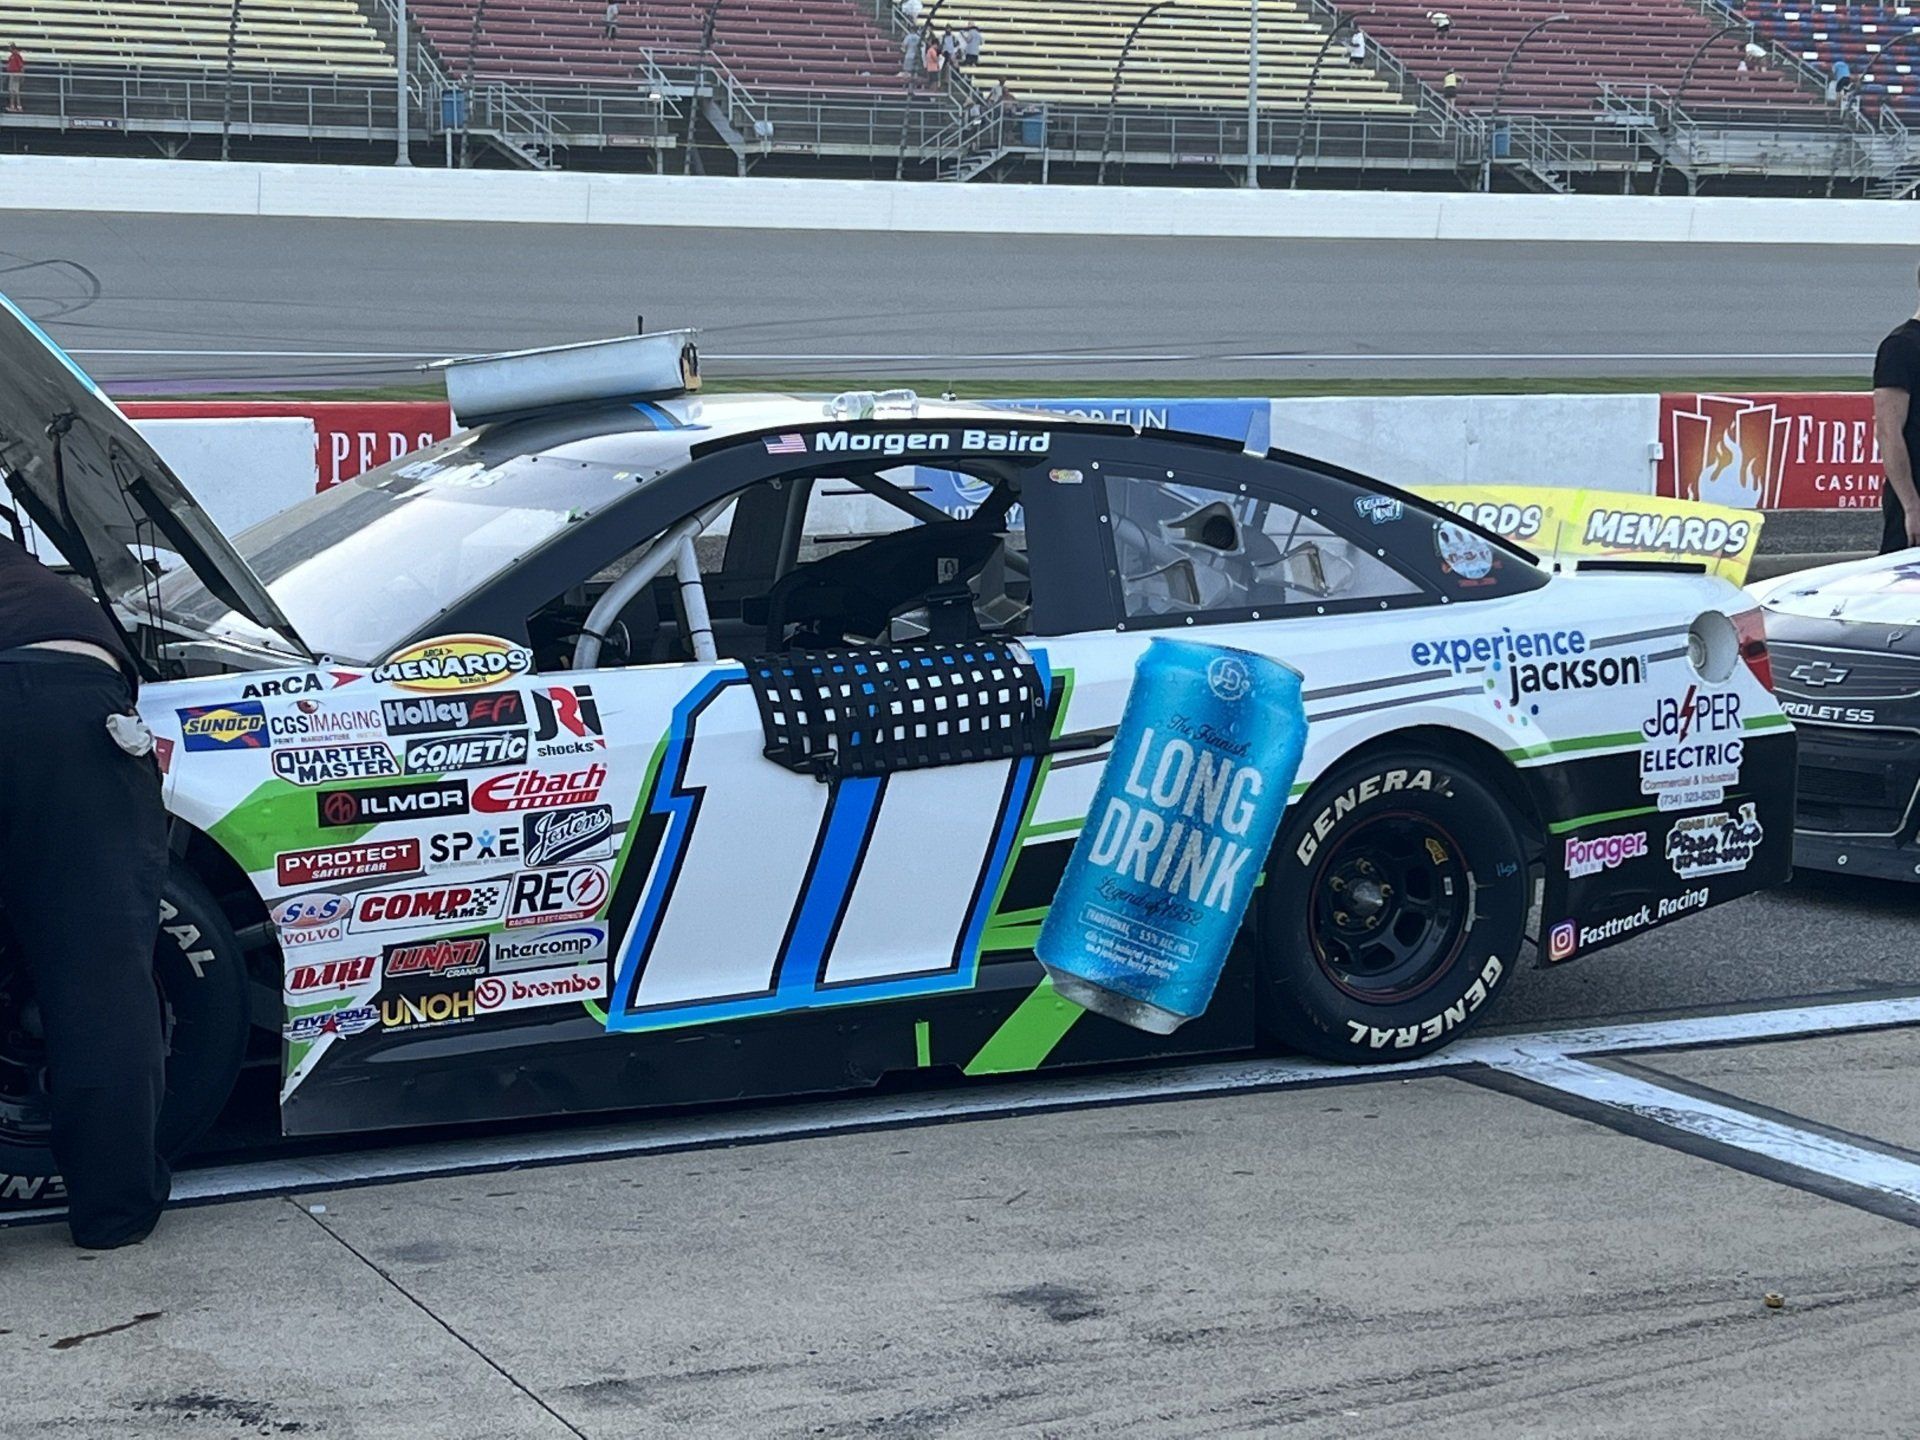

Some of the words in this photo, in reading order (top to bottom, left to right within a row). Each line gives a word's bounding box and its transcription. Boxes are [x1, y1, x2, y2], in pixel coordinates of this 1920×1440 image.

[815, 430, 949, 456] Morgen
[962, 429, 1051, 453] Baird
[1815, 473, 1887, 491] CASIN
[1586, 510, 1750, 552] MENARDS
[1411, 627, 1585, 674] experience
[374, 650, 530, 683] MENARDS
[1508, 653, 1641, 707] jackson
[242, 673, 324, 699] ARCA
[187, 715, 263, 735] SUNOCO
[385, 700, 468, 728] Holley
[469, 694, 517, 722] EFI
[1779, 702, 1846, 721] VROLET
[1846, 708, 1876, 723] SS
[273, 737, 294, 745] PRINT
[300, 734, 350, 744] MANUFACTURE
[406, 735, 528, 768] COMETIC
[537, 741, 595, 758] shocks
[276, 745, 387, 775] QUARTER
[1643, 741, 1741, 773] ELECTRIC
[298, 760, 395, 783] MASTER
[1124, 727, 1263, 838] LONG
[1644, 776, 1692, 791] Commercial
[471, 763, 608, 813] Eibach
[361, 790, 464, 815] ILMOR
[527, 808, 611, 867] Jostens
[1566, 834, 1645, 867] Forager
[285, 844, 411, 872] PYROTECT
[1088, 797, 1253, 914] DRINK
[311, 865, 353, 880] SAFETY
[355, 862, 388, 875] GEAR
[359, 887, 472, 923] COMP
[434, 904, 490, 921] CAMS
[508, 916, 536, 927] RACING
[283, 927, 341, 946] VOLVO
[495, 937, 593, 961] Intercomp
[387, 940, 482, 972] LUNATI
[511, 973, 602, 1001] brembo
[381, 989, 476, 1026] UNOH
[1346, 954, 1504, 1050] GENERAL
[292, 1013, 331, 1032] FIVE
[335, 1007, 374, 1021] STAR
